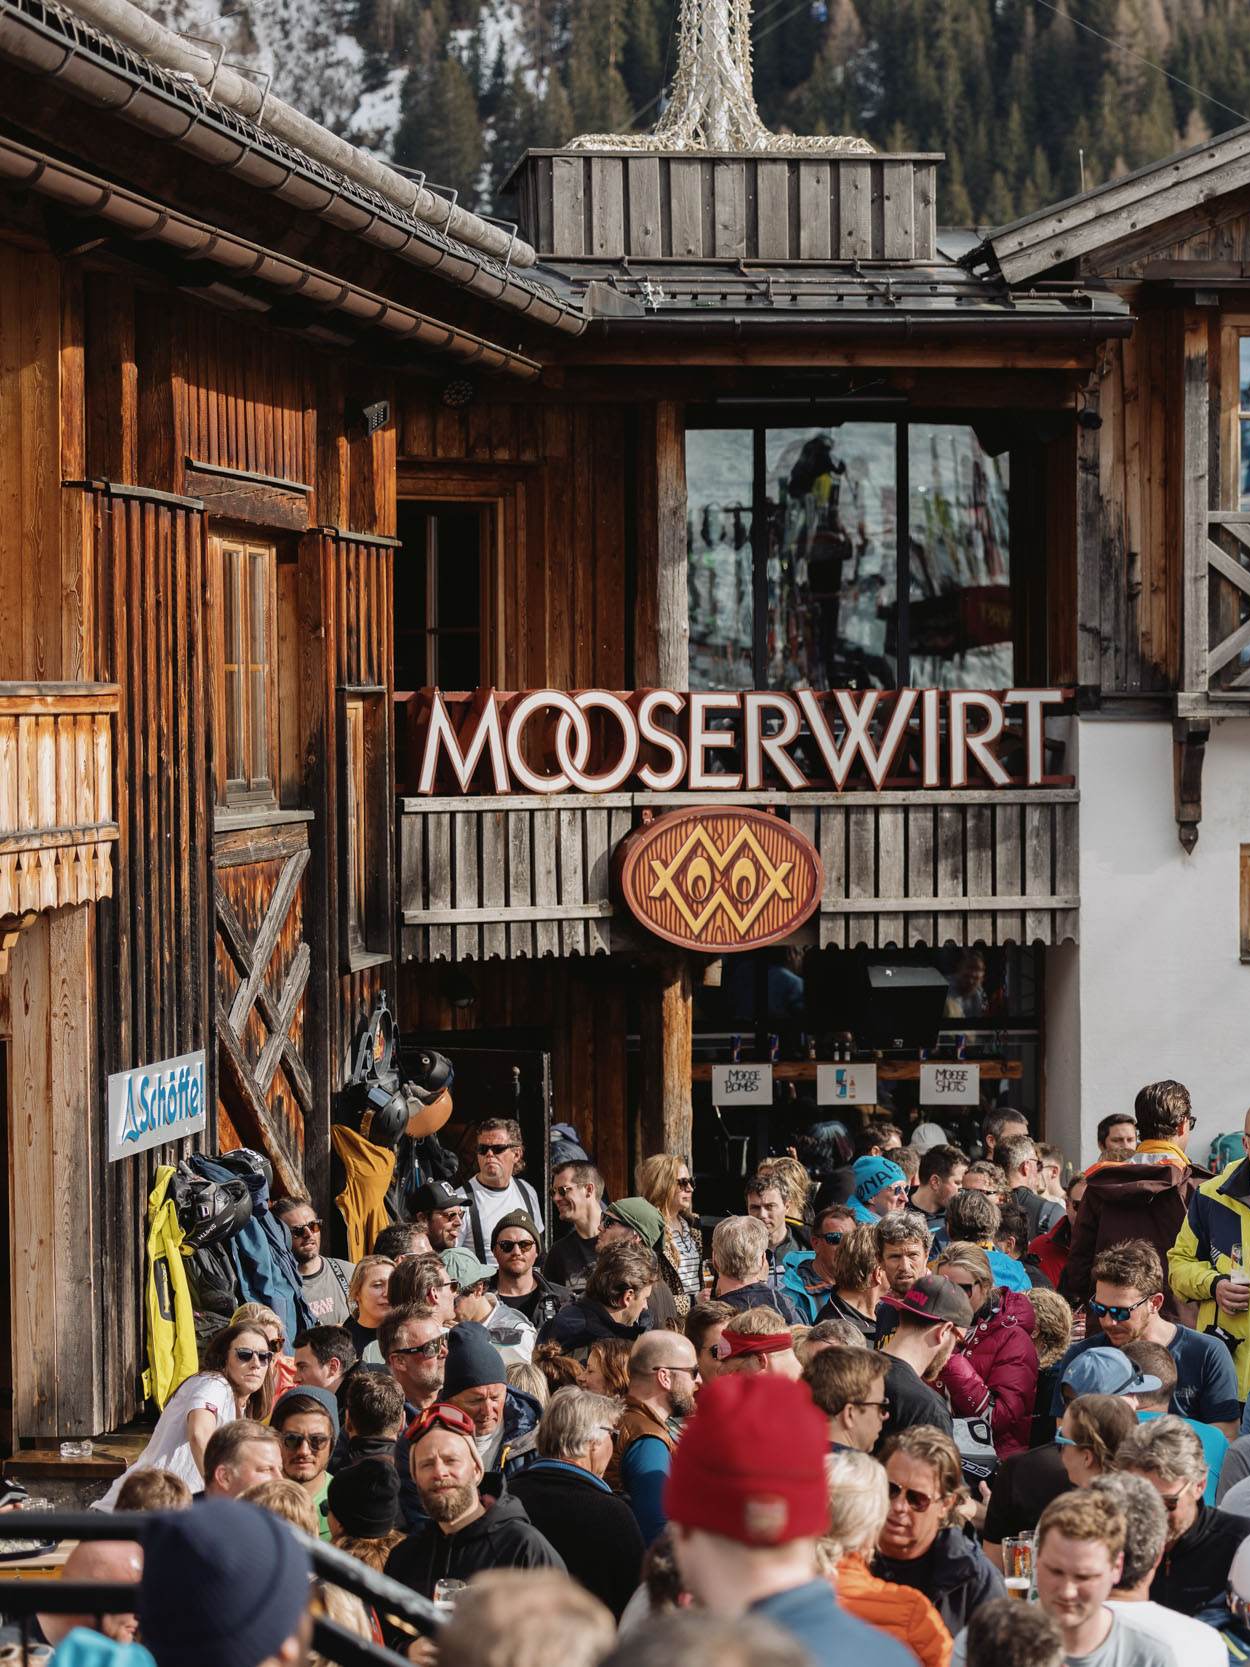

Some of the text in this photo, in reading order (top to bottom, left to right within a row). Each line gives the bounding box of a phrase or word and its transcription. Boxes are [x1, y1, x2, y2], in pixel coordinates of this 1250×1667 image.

[417, 686, 1065, 794] MOOSERWIRT
[138, 1062, 204, 1134] Schöffel
[198, 1223, 217, 1241] SMITH
